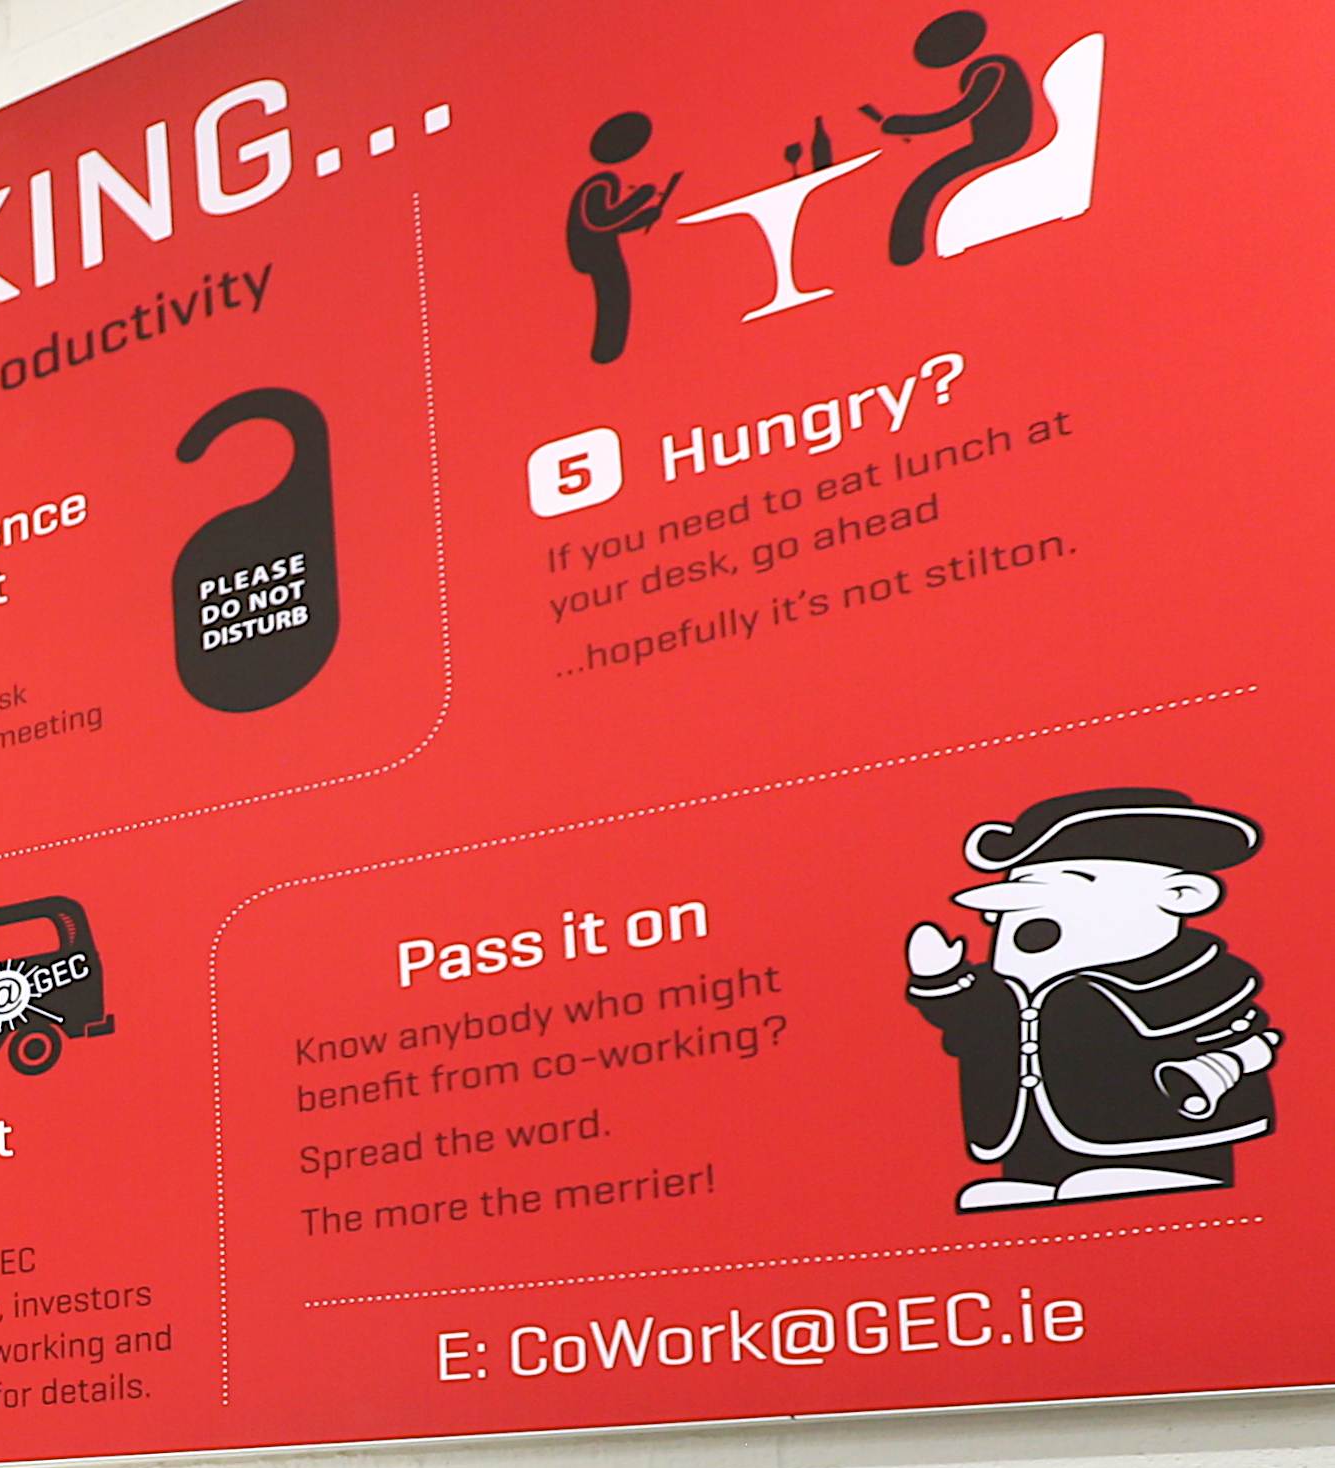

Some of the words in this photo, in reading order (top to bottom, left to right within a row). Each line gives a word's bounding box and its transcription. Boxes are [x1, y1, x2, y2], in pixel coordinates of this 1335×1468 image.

[558, 453, 592, 495] 5
[661, 352, 965, 483] Hungry?
[549, 543, 570, 573] If
[582, 531, 644, 570] you
[659, 495, 749, 544] need
[763, 489, 802, 514] to
[817, 464, 881, 501] eat
[895, 428, 1011, 480] lunch
[1028, 412, 1072, 444] at
[200, 553, 306, 600] PLEASE
[201, 599, 241, 625] DO
[249, 580, 306, 612] NOT
[550, 580, 628, 624] your
[642, 551, 737, 594] desk,
[753, 537, 798, 574] go
[814, 493, 938, 550] ahead
[202, 606, 309, 650] DISTURB
[557, 608, 758, 677] ...hopefully
[773, 590, 829, 625] it's
[844, 571, 911, 608] not
[926, 537, 1075, 588] stilton.
[400, 932, 542, 986] Pass
[564, 912, 607, 958] it
[627, 903, 706, 947] on
[297, 1033, 387, 1065] Know
[399, 1002, 552, 1050] anybody
[564, 991, 643, 1024] who
[659, 967, 781, 1010] might
[298, 1071, 419, 1112] benefit
[431, 1062, 518, 1093] from
[533, 1015, 787, 1079] co-working?
[300, 1132, 422, 1179] Spread
[435, 1128, 494, 1157] the
[506, 1109, 610, 1148] word.
[440, 1332, 485, 1380] E:
[512, 1288, 1083, 1375] CoWork@GEC.ie
